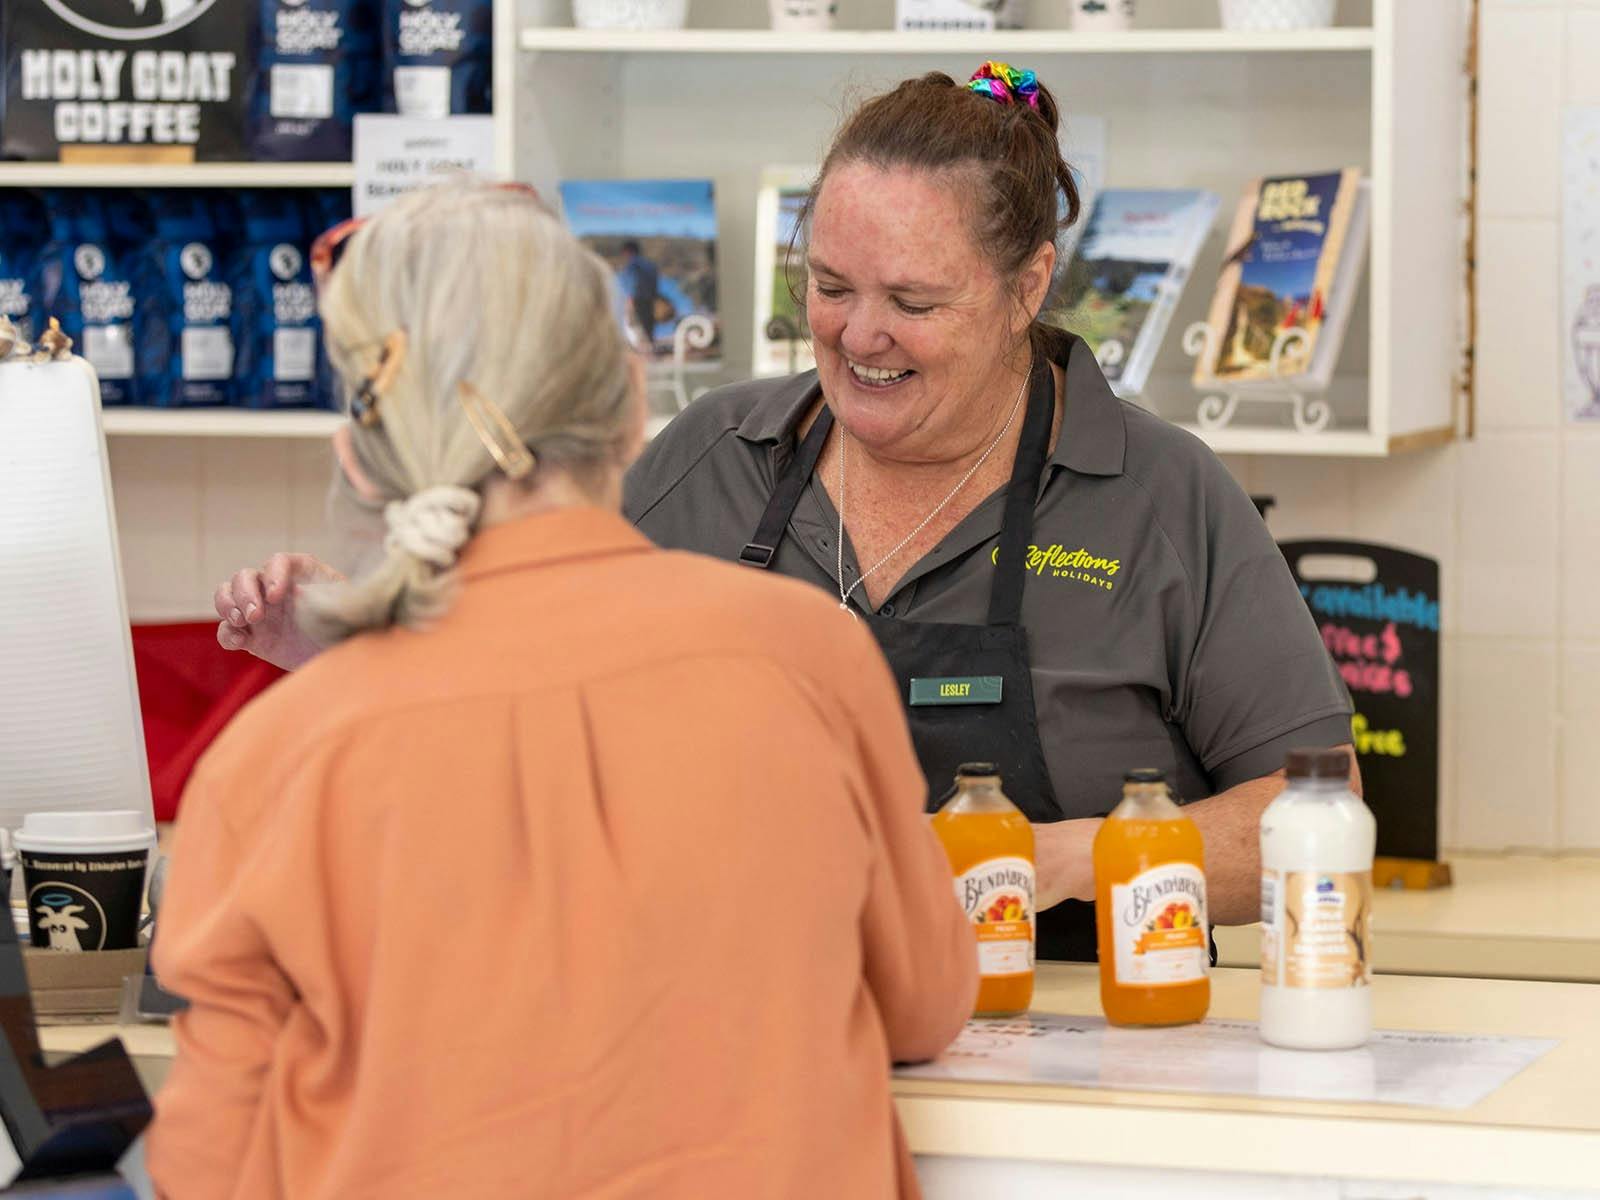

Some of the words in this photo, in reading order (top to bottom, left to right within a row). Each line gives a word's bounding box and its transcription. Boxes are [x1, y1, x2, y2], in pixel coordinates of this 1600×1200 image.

[21, 49, 126, 100] HOLY
[131, 51, 236, 101] GOAT
[54, 102, 200, 142] COFFEE
[1024, 544, 1120, 576] Reflections
[1052, 569, 1113, 591] HOLIDAYS
[940, 682, 971, 697] LESLEY
